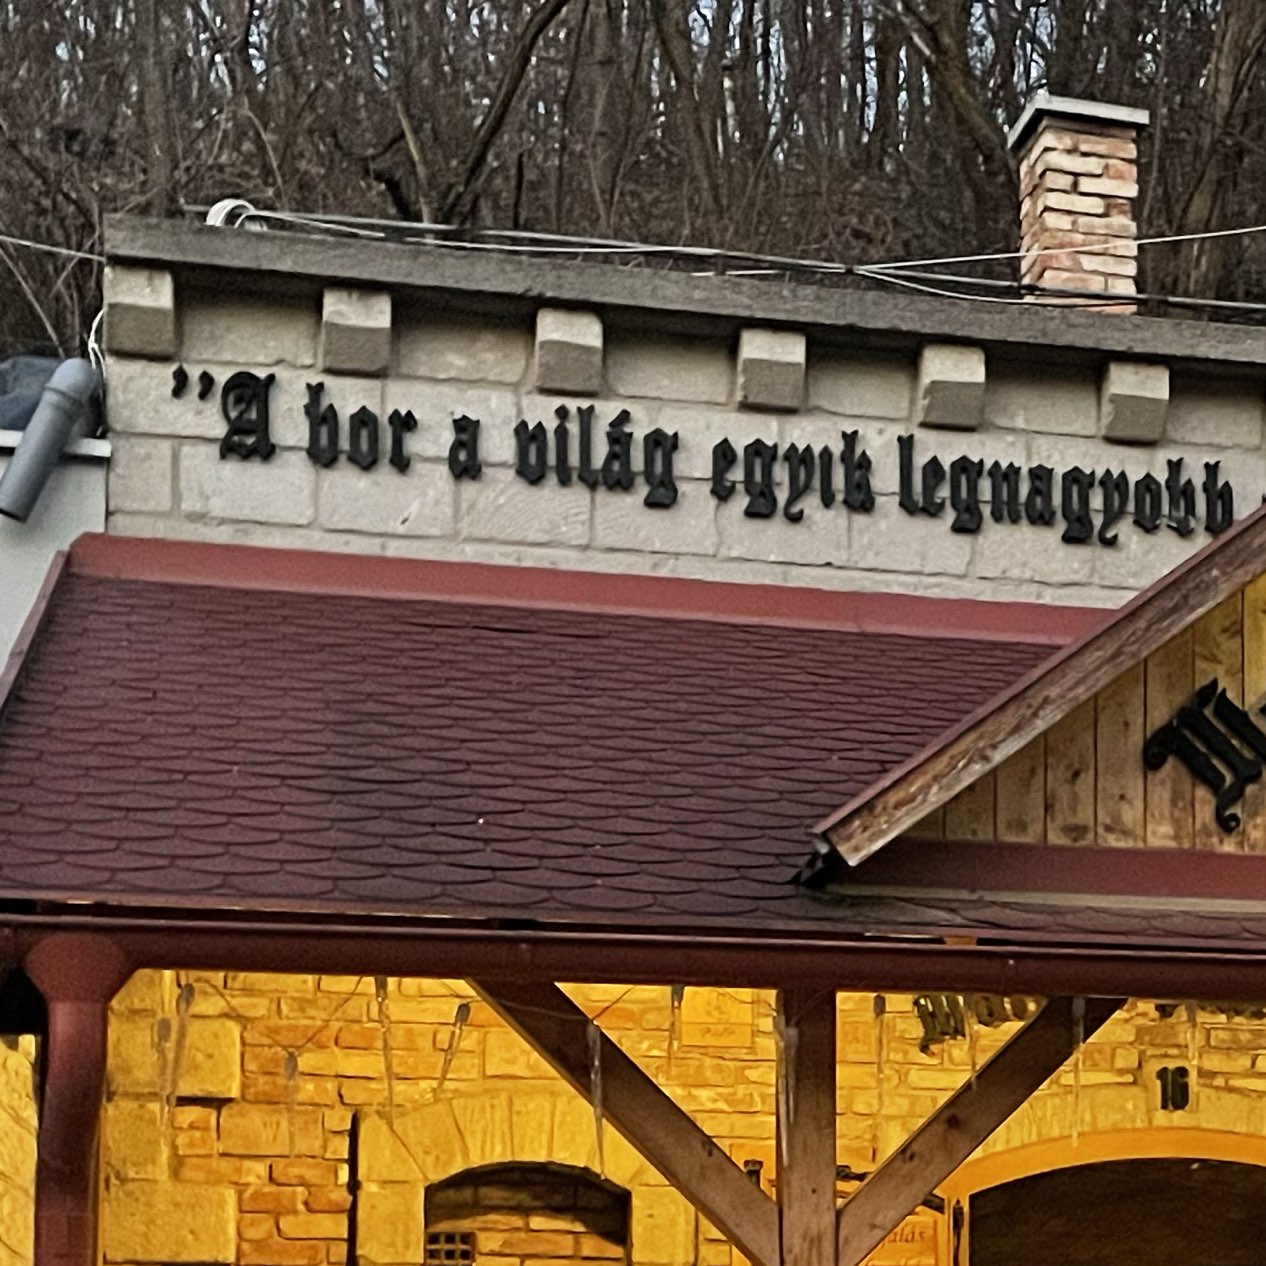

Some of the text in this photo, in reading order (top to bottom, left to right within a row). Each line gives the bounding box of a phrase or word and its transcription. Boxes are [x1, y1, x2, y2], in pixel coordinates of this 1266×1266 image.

[304, 381, 418, 473] bor
[448, 413, 482, 480] a
[514, 403, 679, 508] világ
[710, 429, 875, 522] egyik
[1156, 1066, 1190, 1110] 16
